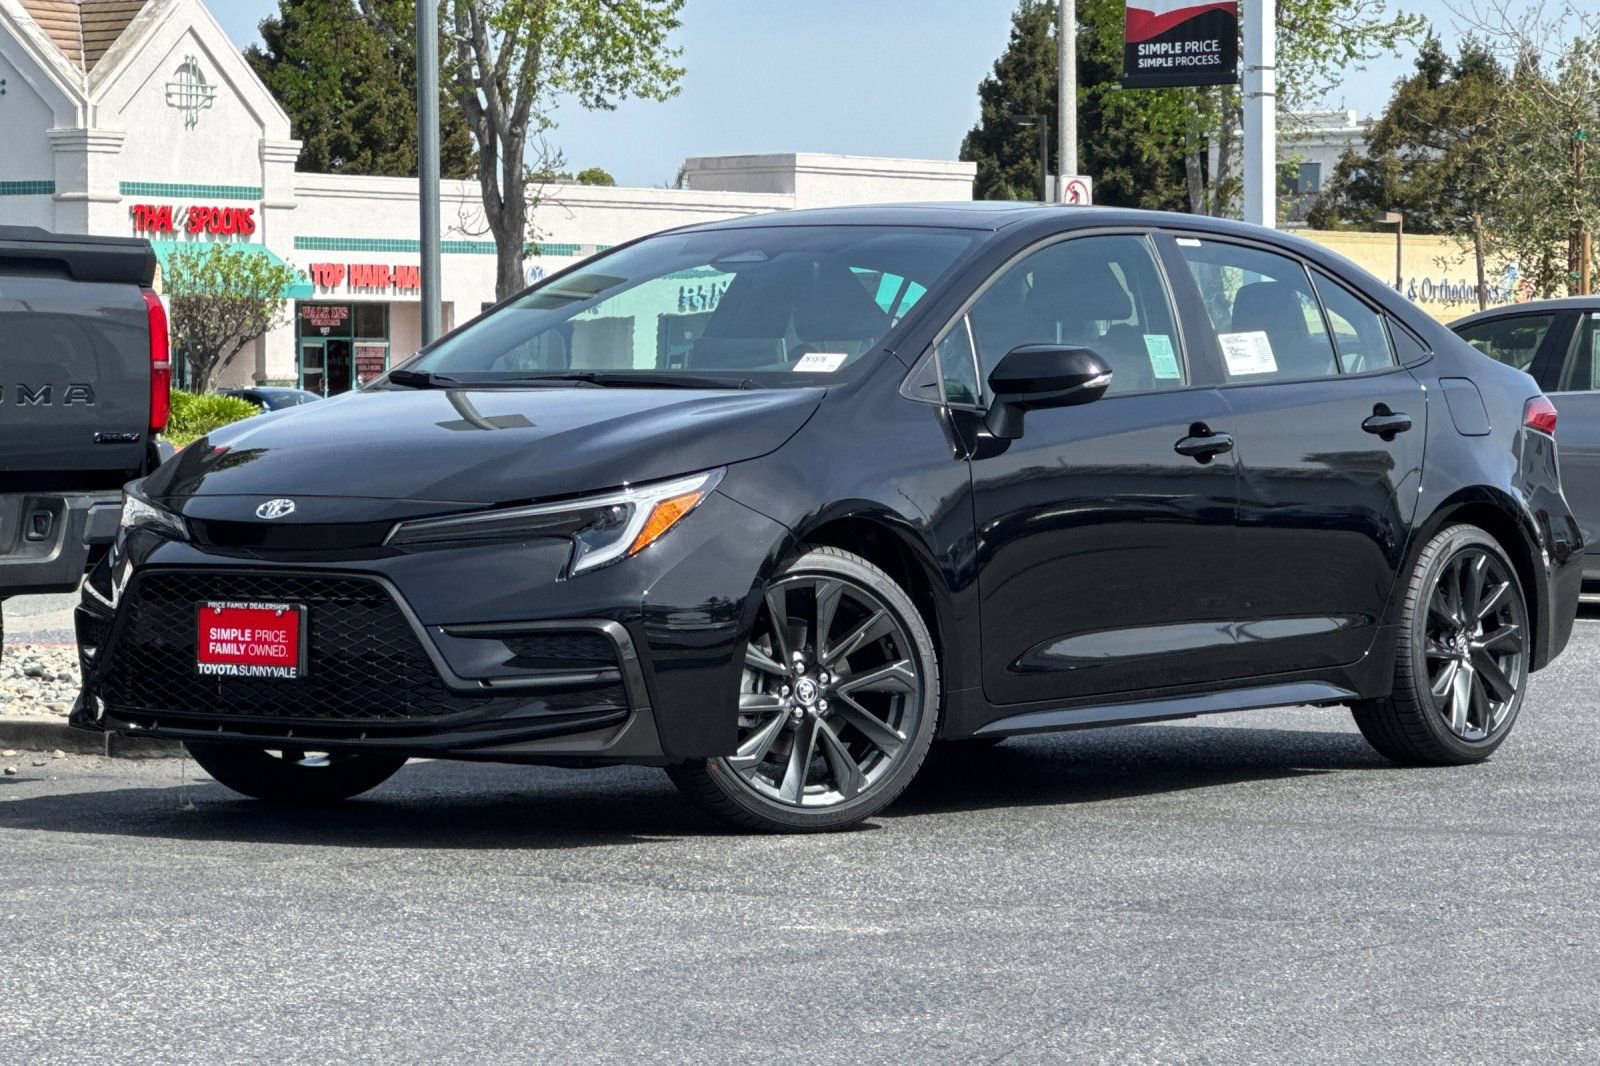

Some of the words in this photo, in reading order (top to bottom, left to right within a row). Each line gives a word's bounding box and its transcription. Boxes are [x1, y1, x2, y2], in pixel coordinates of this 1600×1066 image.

[1138, 42, 1182, 56] SIMPLE
[1184, 39, 1222, 53] PRICE.
[1138, 57, 1174, 69] SIMPLE
[1175, 54, 1222, 67] PROCESS.
[133, 203, 173, 233] THAI
[187, 205, 256, 236] SPOONS
[311, 262, 346, 288] TOP
[348, 263, 421, 289] HAIR-NA
[227, 602, 249, 610] FAMILY
[249, 603, 290, 611] DEALERSHIPS
[209, 627, 252, 641] SIMPLE
[254, 629, 289, 643] PRICE.
[209, 642, 247, 655] FAMILY
[248, 643, 289, 658] OWNED.
[198, 663, 238, 676] TOYOTA
[238, 665, 297, 679] SUNNYVALE
